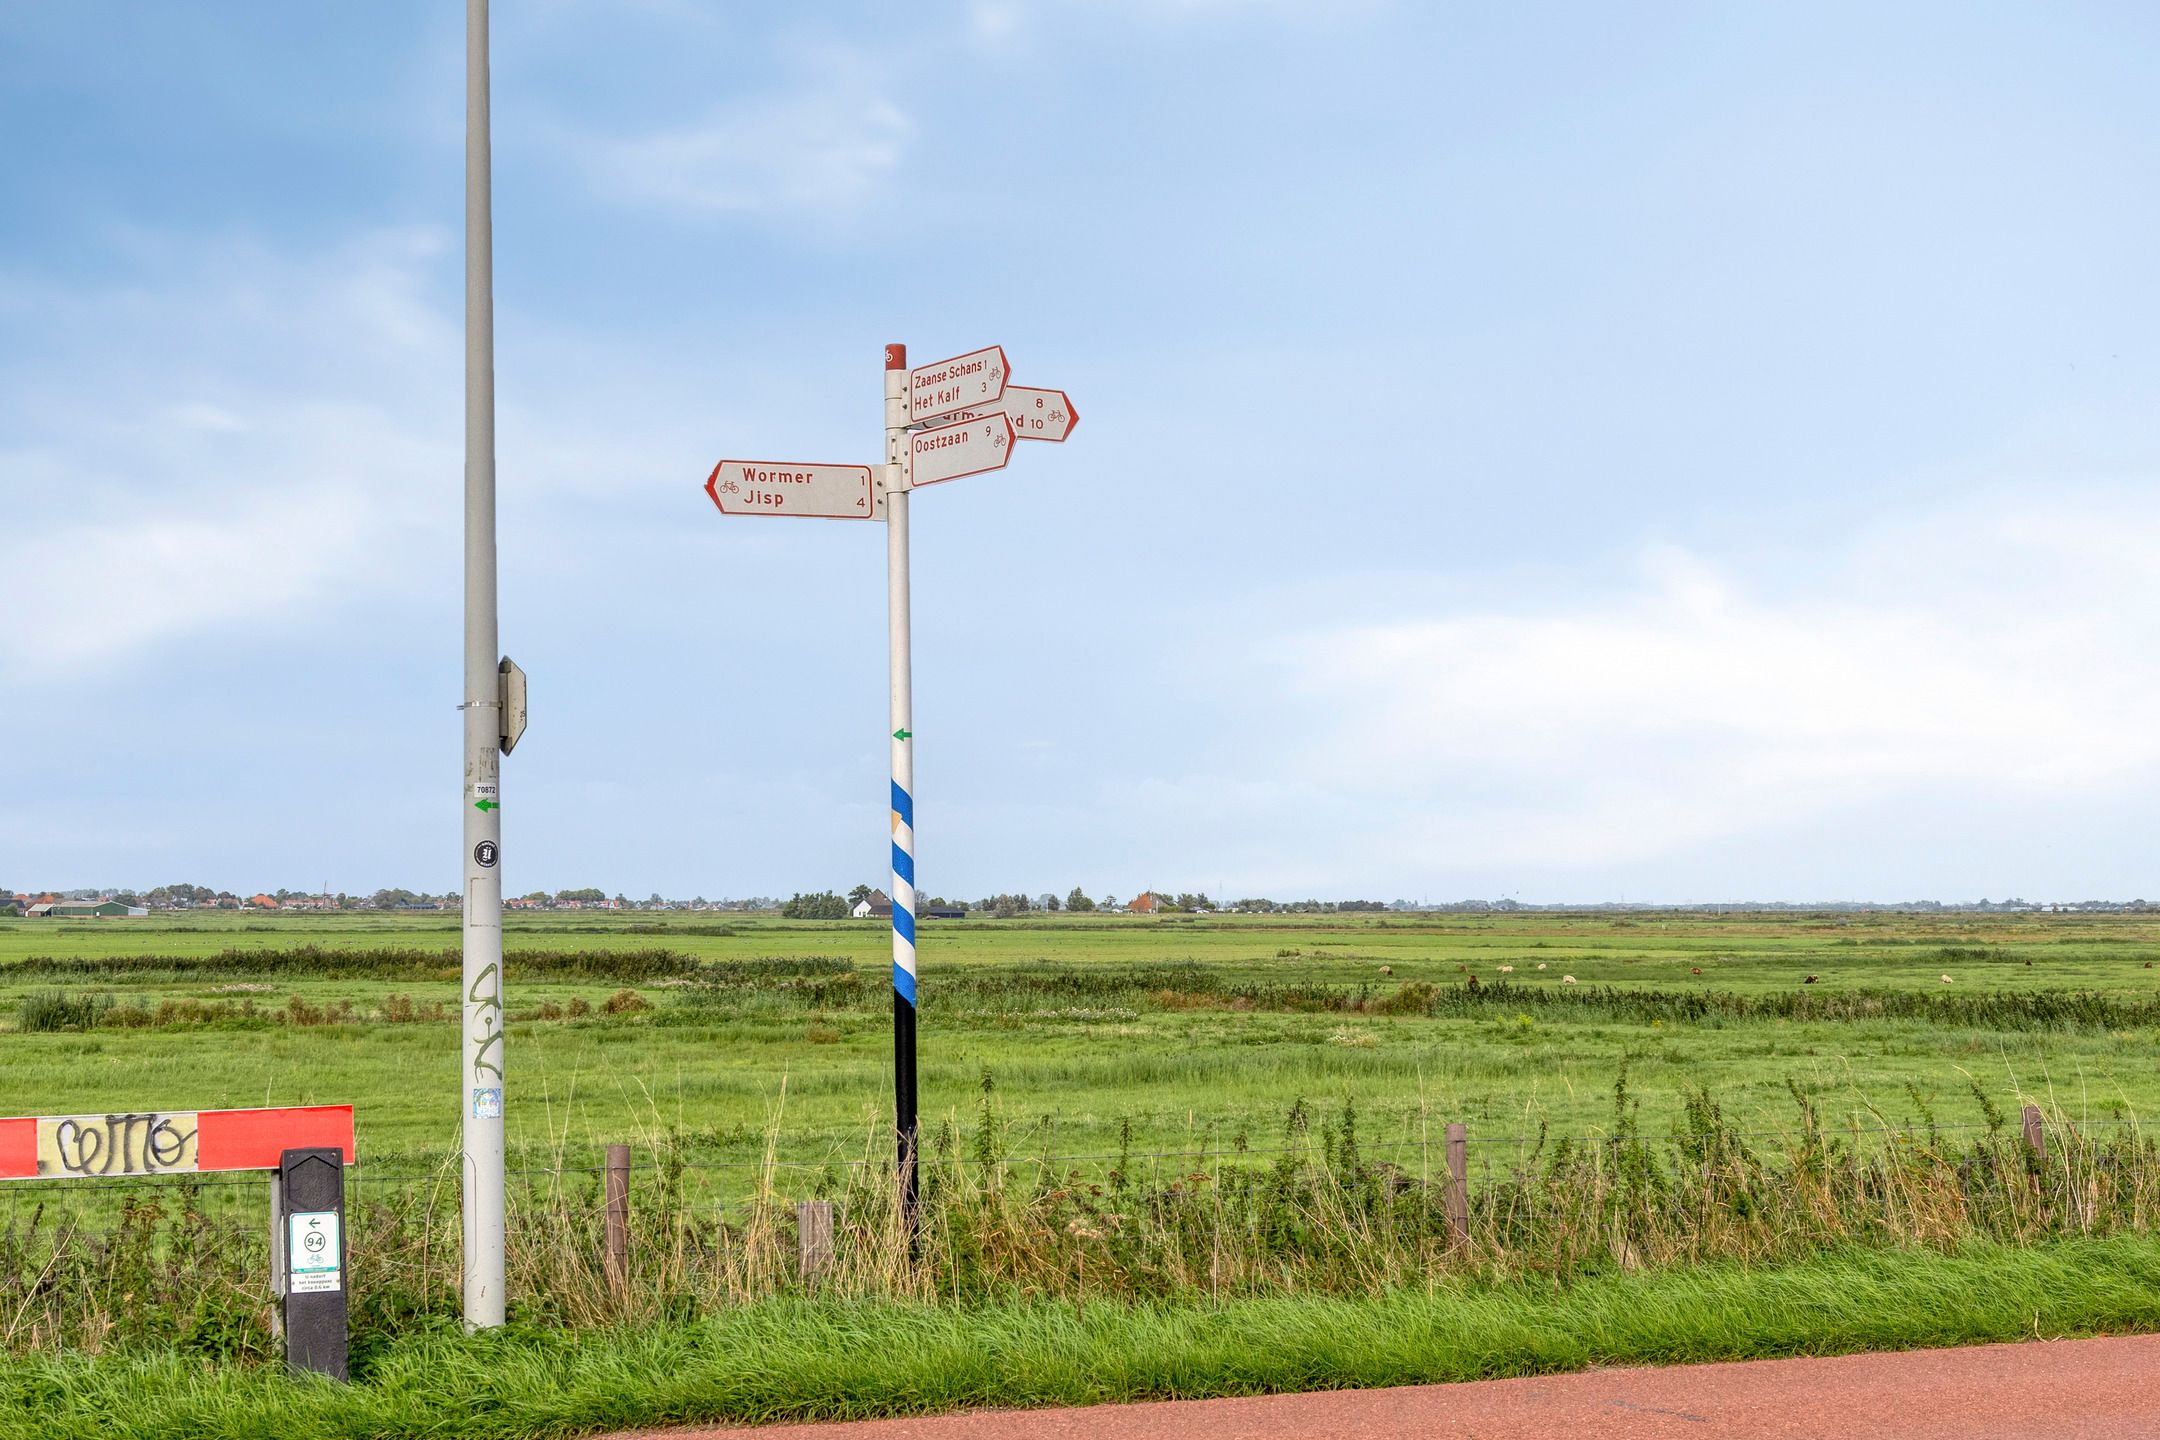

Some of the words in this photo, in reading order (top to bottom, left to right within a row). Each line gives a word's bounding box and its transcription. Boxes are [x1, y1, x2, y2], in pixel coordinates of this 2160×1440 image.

[915, 372, 947, 389] Zaanse
[949, 361, 982, 379] Schans
[914, 393, 933, 411] Het
[937, 386, 960, 405] Kalf
[981, 382, 987, 393] 3
[1036, 398, 1044, 409] 8
[1030, 418, 1044, 430] 10
[915, 431, 968, 454] Oostzaan
[985, 425, 991, 437] 9
[742, 467, 813, 484] Wormer
[744, 490, 784, 507] Jisp
[856, 497, 866, 508] 4
[477, 786, 496, 794] 70872
[307, 1237, 323, 1247] 94
